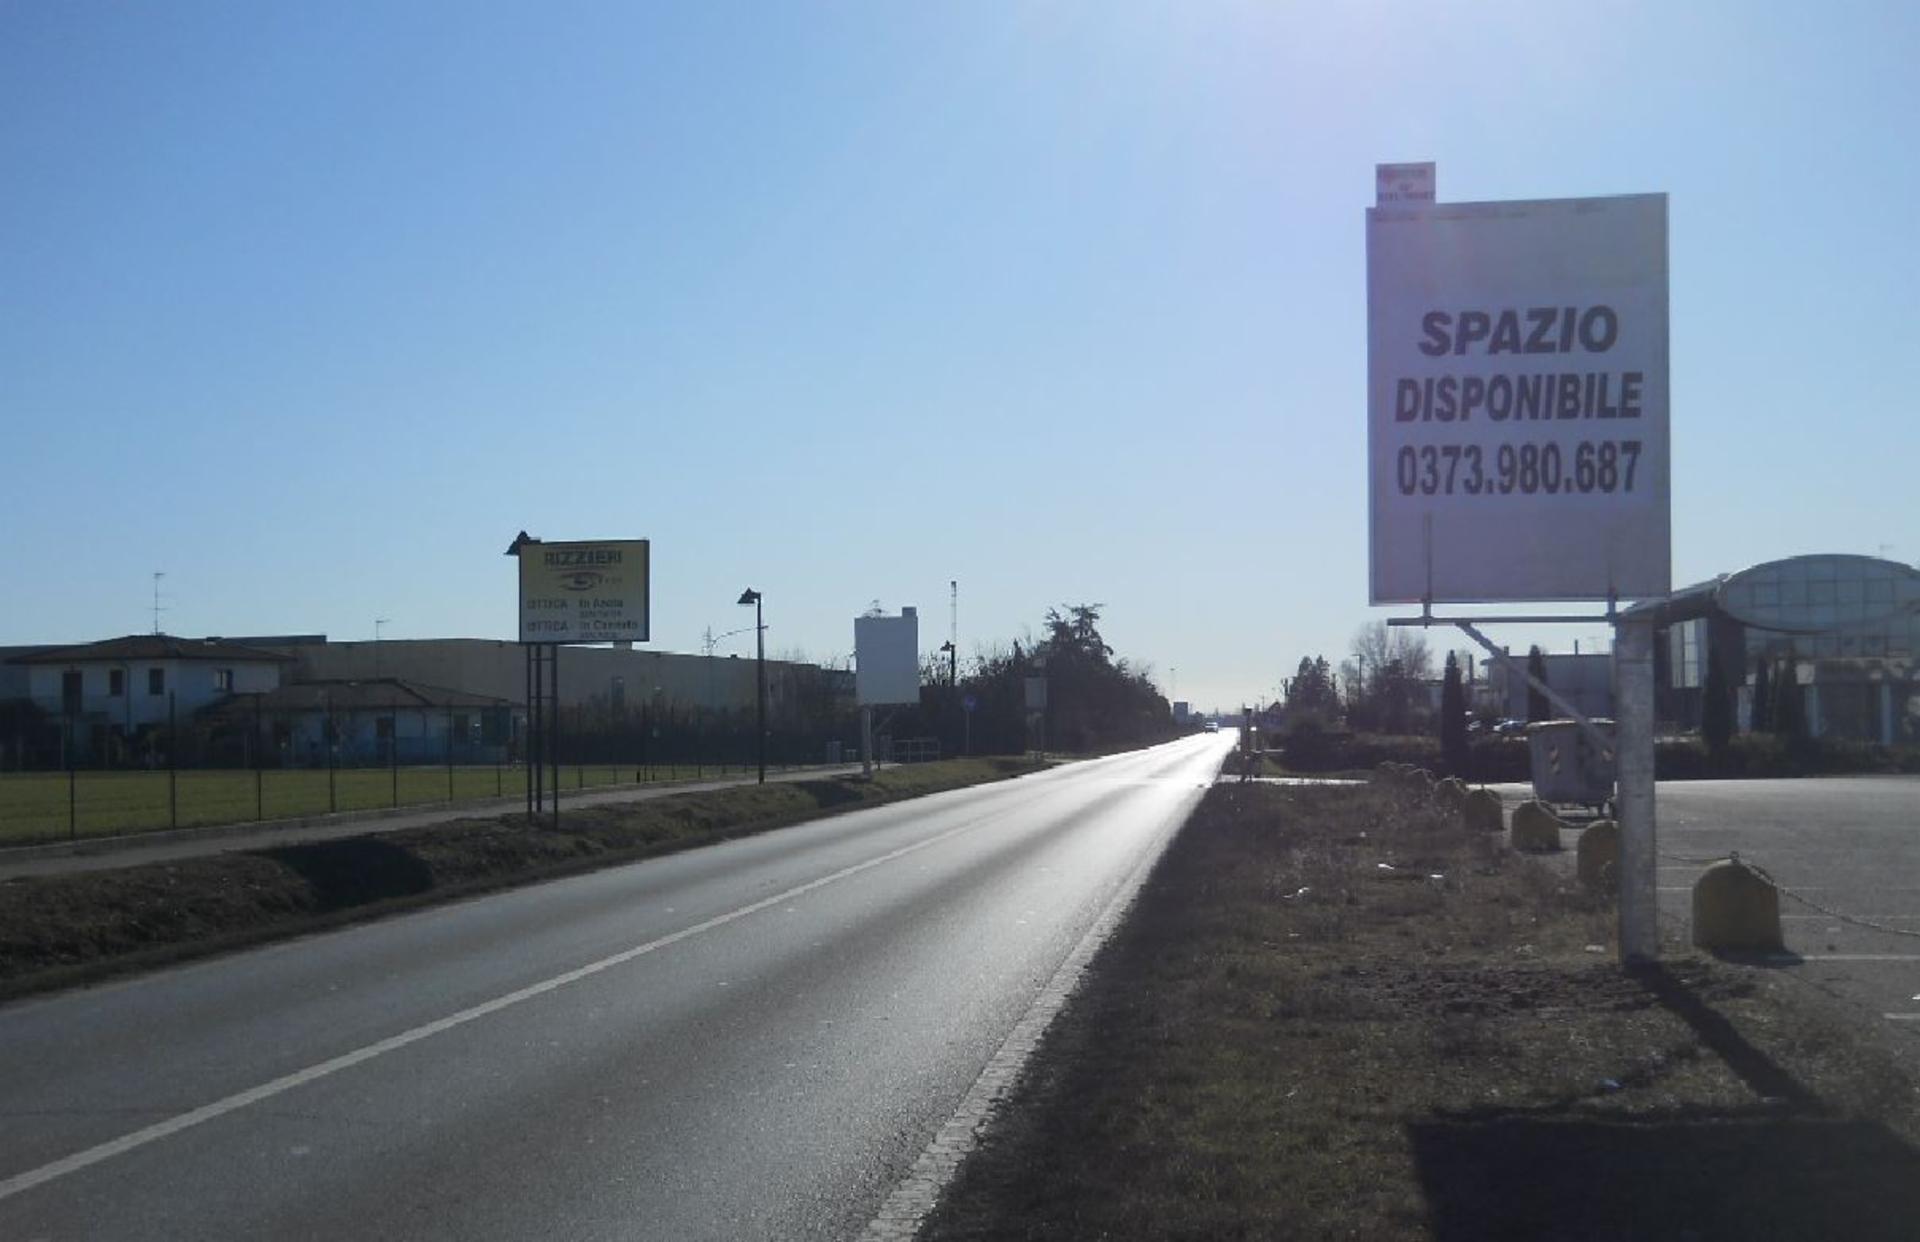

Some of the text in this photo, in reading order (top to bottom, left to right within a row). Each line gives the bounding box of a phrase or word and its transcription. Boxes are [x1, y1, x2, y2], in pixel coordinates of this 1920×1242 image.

[1417, 305, 1618, 356] SPAZIO
[1395, 371, 1643, 422] DISPONIBILE
[1397, 440, 1642, 495] 0373.980.687
[544, 550, 623, 565] RIZZIERI
